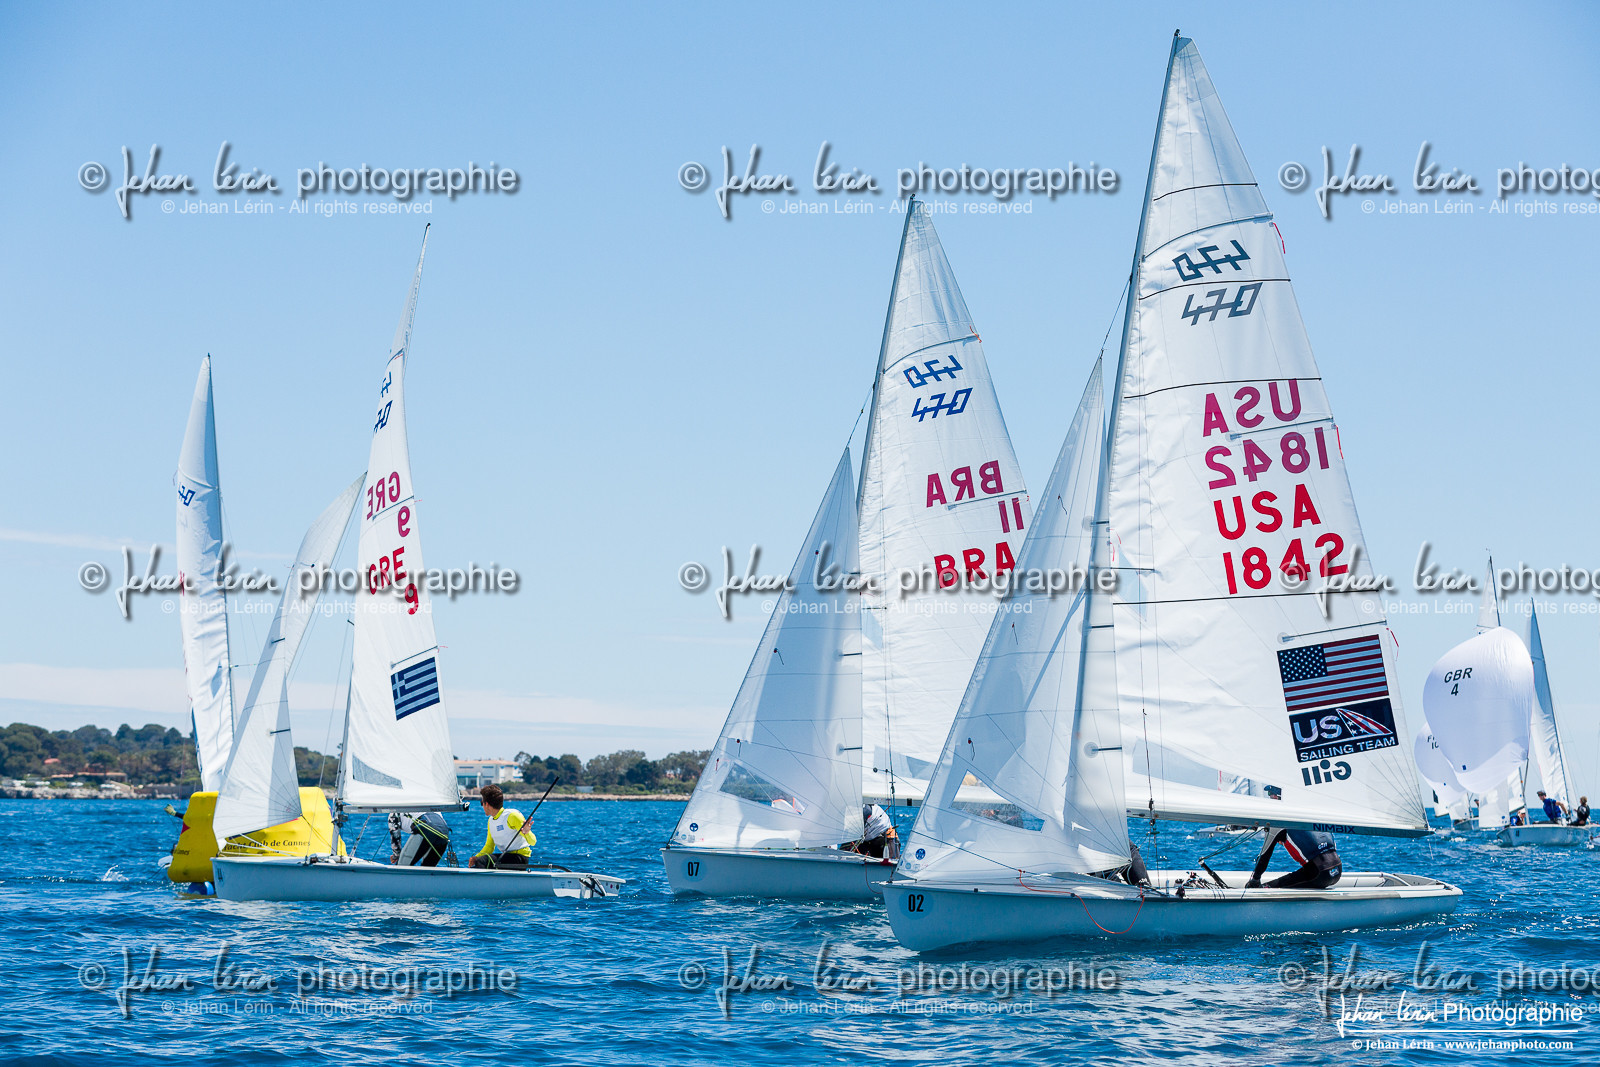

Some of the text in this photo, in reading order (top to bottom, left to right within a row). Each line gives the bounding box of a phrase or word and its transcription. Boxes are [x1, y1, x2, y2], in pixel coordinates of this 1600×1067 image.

[1181, 282, 1263, 326] 470
[911, 387, 973, 422] 470
[1213, 483, 1322, 541] USA
[368, 546, 407, 595] GRE
[934, 541, 1016, 590] BRA
[1222, 532, 1349, 595] 1842
[405, 583, 419, 615] 9
[1444, 667, 1473, 683] GBR
[1450, 683, 1459, 696] 4
[1300, 736, 1396, 761] SAILING TEAM
[1313, 823, 1356, 834] NIMBIX
[687, 861, 700, 877] 07
[908, 894, 925, 912] 02
